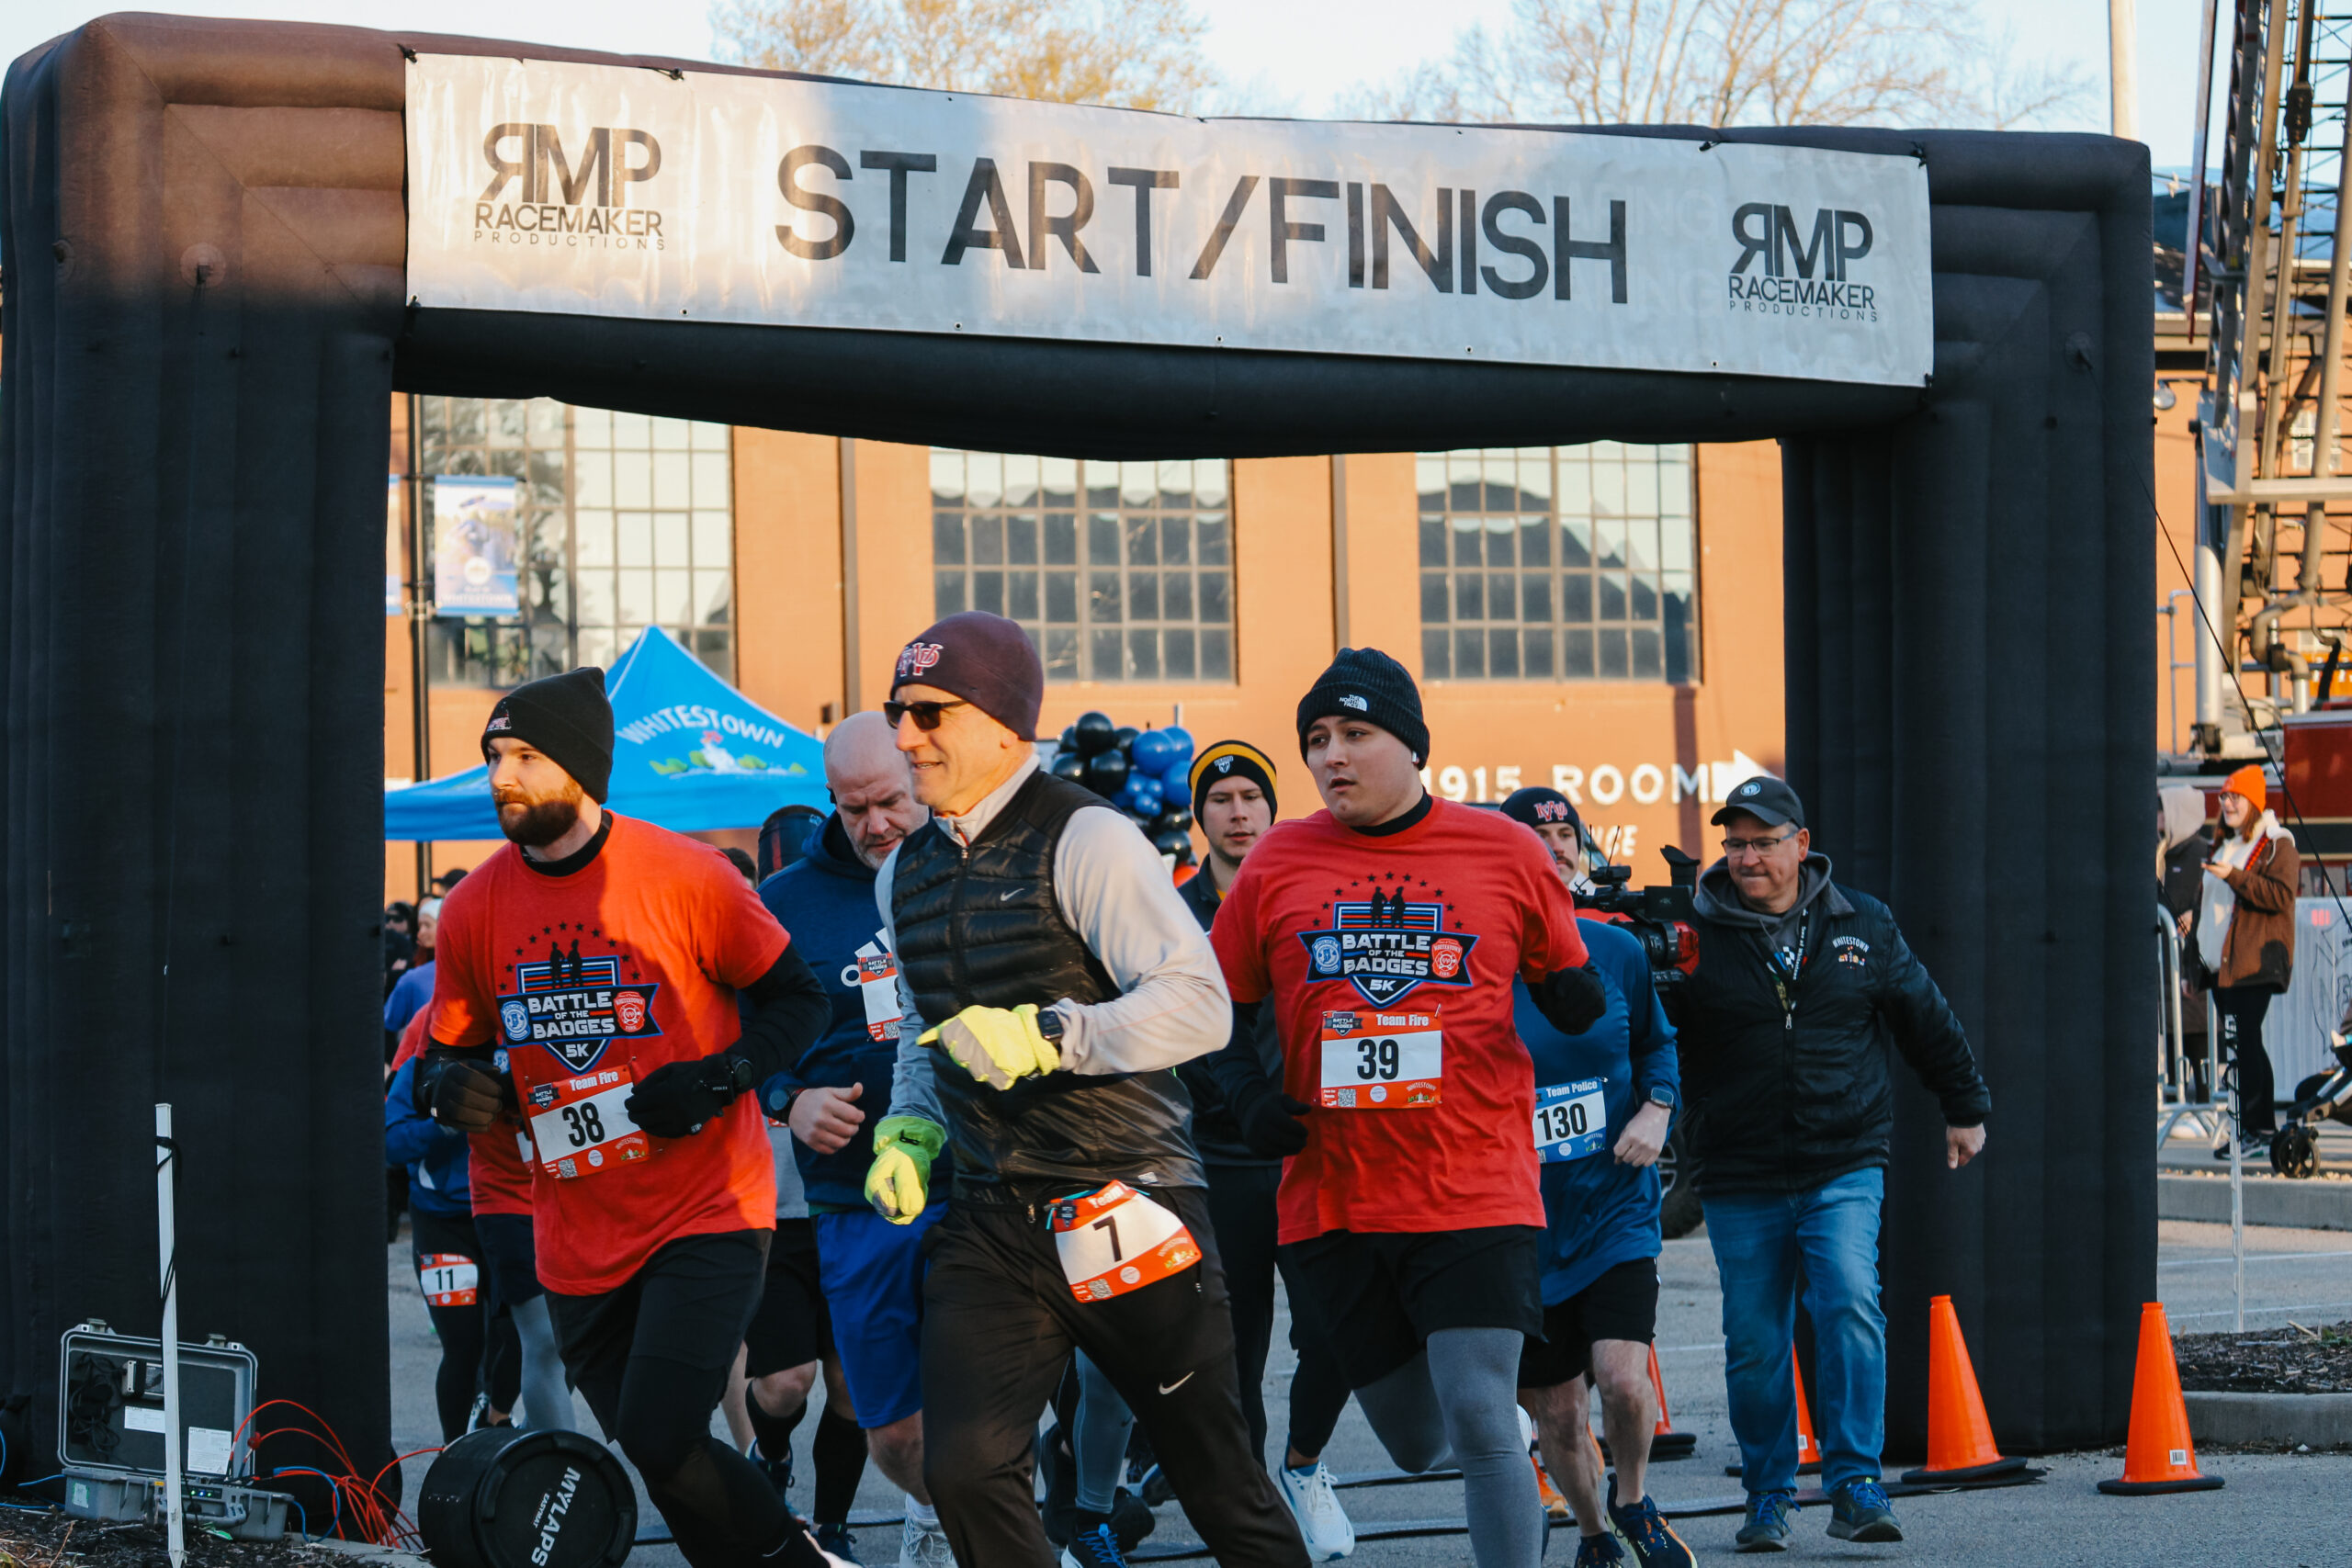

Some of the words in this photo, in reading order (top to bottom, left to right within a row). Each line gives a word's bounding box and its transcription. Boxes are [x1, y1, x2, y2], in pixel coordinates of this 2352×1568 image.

[474, 202, 663, 237] RACEMAKER
[775, 144, 1629, 305] START/FINISH
[474, 230, 665, 251] PRODUCTIONS
[1728, 275, 1876, 310] RACEMAKER
[1729, 299, 1878, 322] PRODUCTIONS
[615, 705, 785, 749] WHITESTOWN
[1552, 763, 1709, 805] ROOM
[1342, 934, 1431, 951] BATTLE
[1832, 935, 1870, 953] WHITESTOWN
[1343, 958, 1429, 976] BADGES
[1370, 979, 1396, 991] 5K
[527, 991, 613, 1014] BATTLE
[554, 1011, 568, 1021] OF
[570, 1010, 589, 1019] THE
[1376, 1014, 1407, 1026] Team
[1408, 1014, 1430, 1026] Fire
[533, 1018, 616, 1039] BADGES
[565, 1043, 590, 1058] 5K
[1357, 1039, 1399, 1080] 39
[570, 1076, 598, 1091] Team
[598, 1071, 619, 1085] Fire
[1546, 1086, 1570, 1098] Team
[562, 1101, 605, 1147] 38
[1537, 1102, 1588, 1141] 130
[1088, 1185, 1125, 1209] Team
[1092, 1214, 1123, 1263] 7
[435, 1268, 454, 1291] 11
[531, 1466, 581, 1567] MYLAPS
